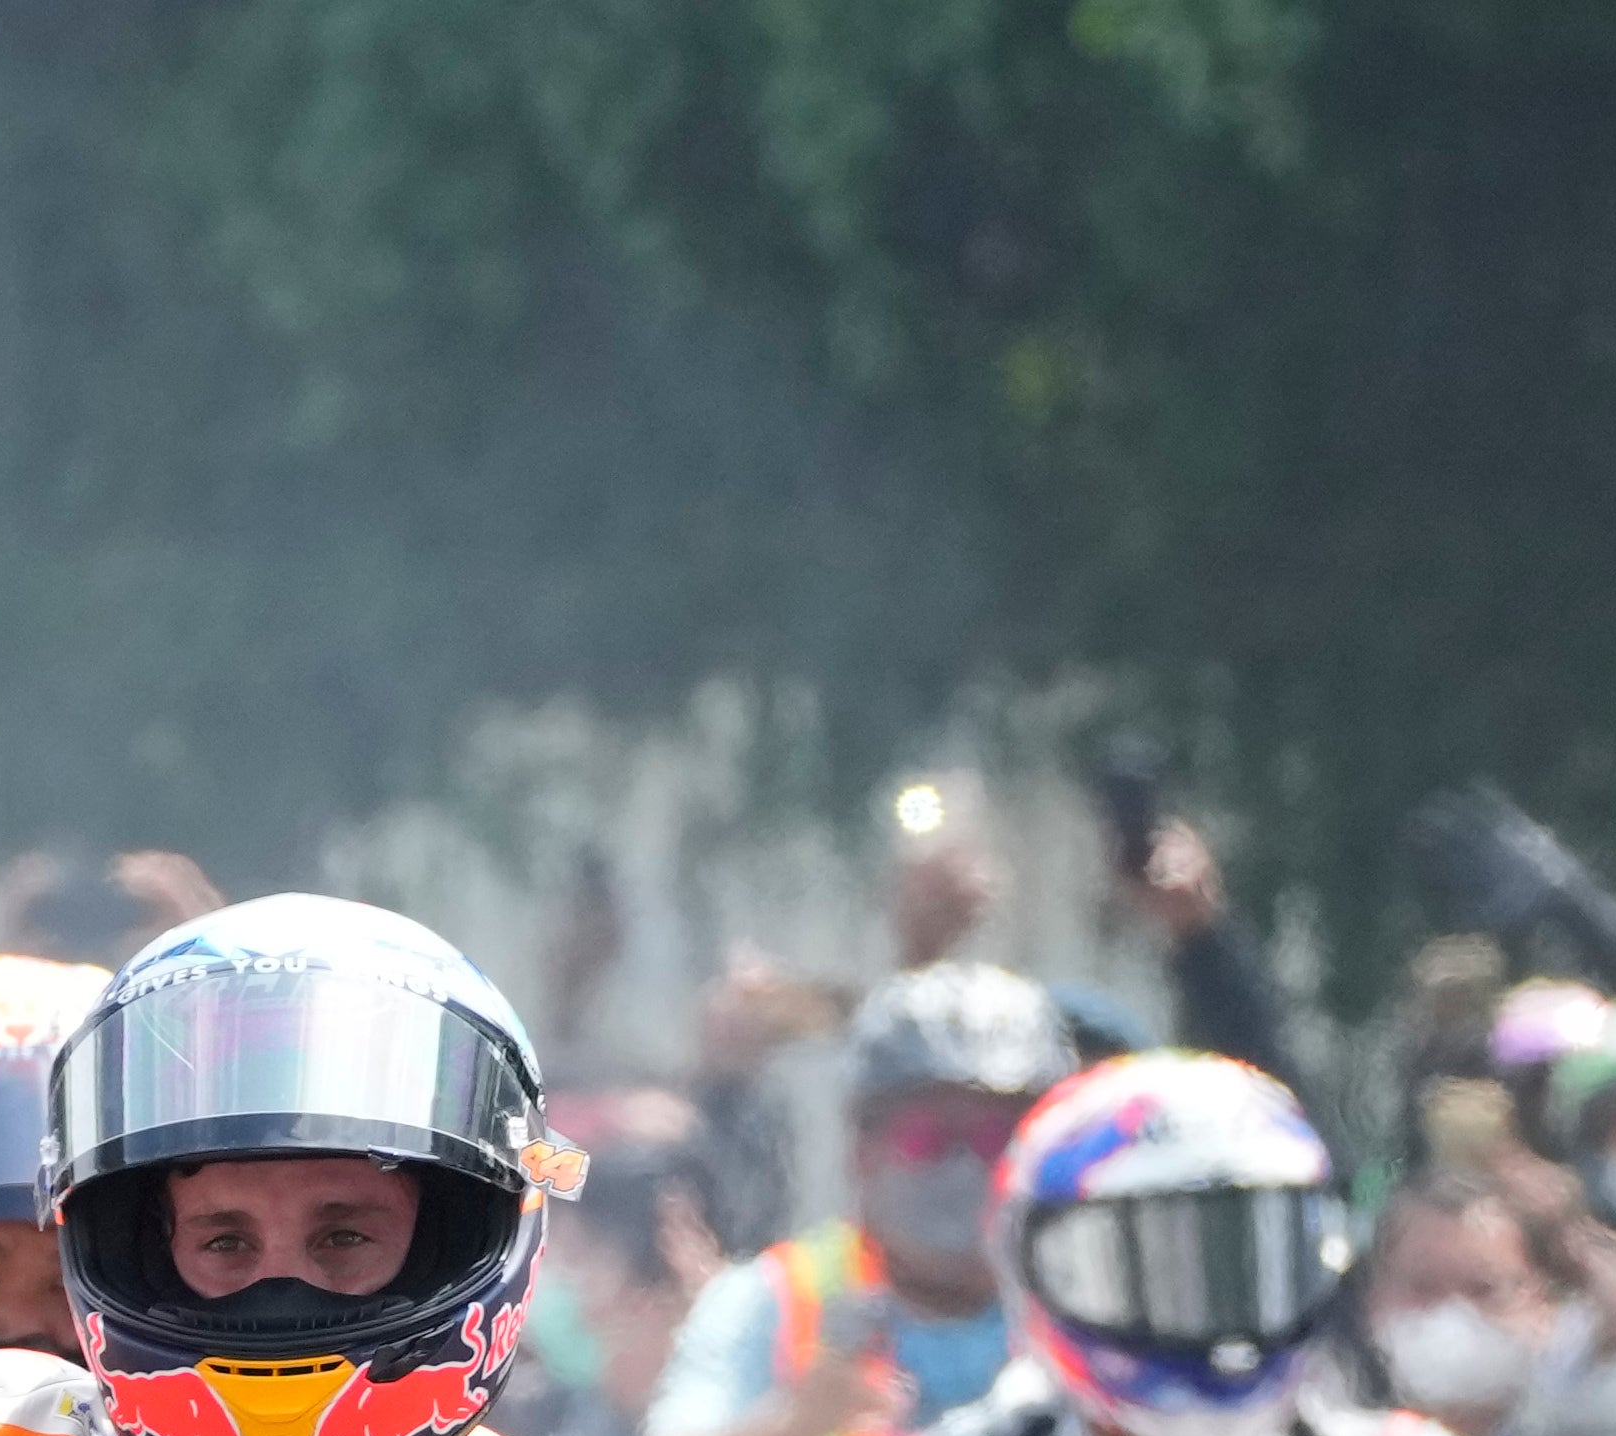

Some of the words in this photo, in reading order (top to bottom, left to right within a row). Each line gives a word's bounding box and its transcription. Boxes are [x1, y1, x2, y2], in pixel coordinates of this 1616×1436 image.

[117, 963, 208, 1004] GIVES
[234, 955, 307, 975] YOU
[521, 1144, 582, 1192] 44
